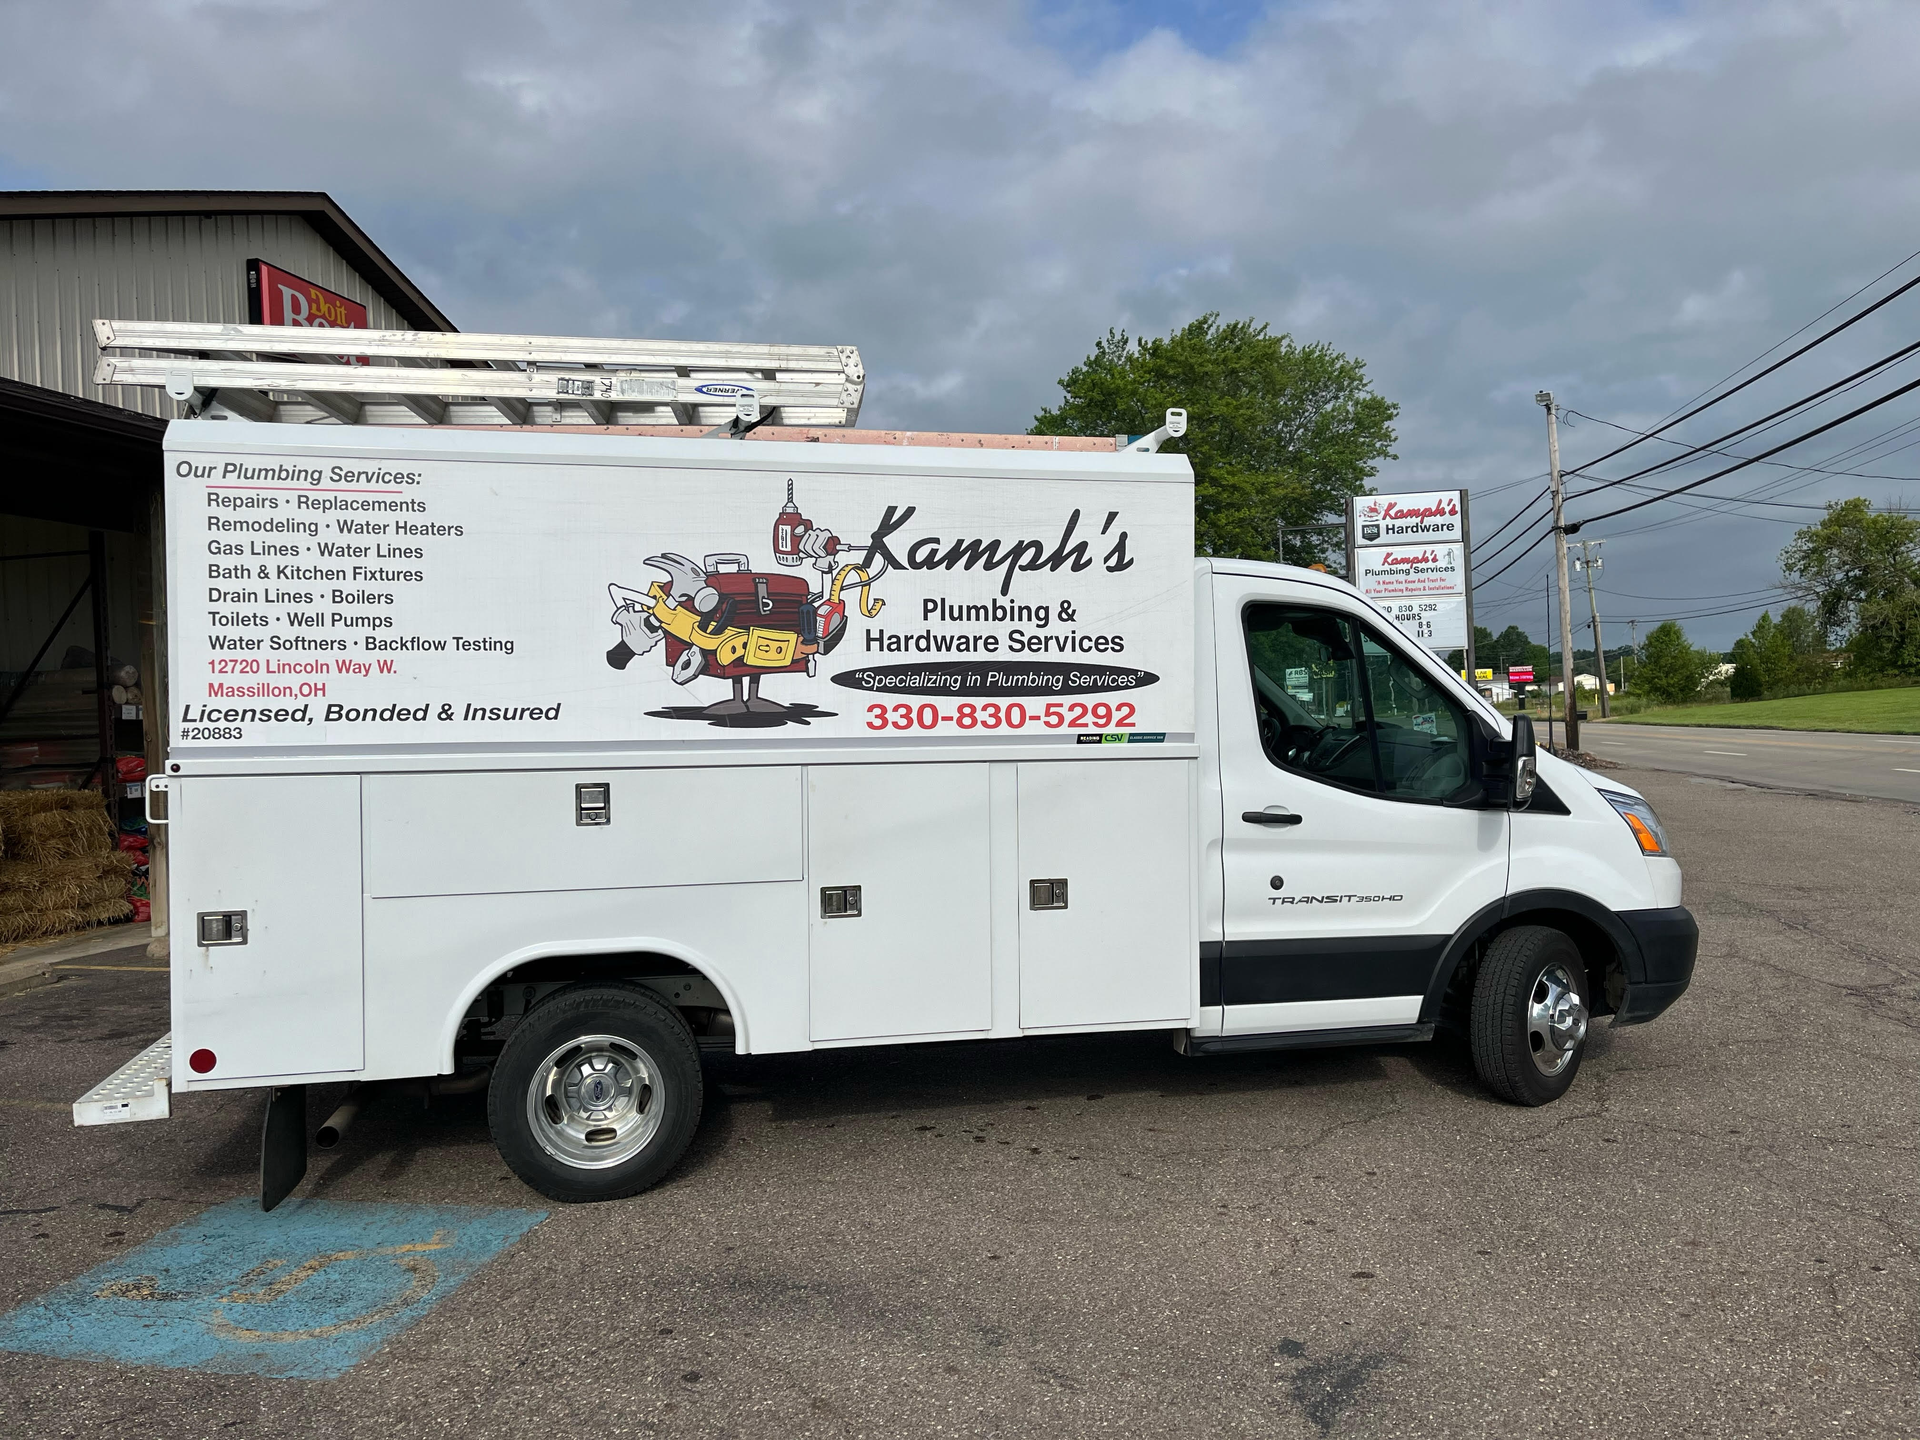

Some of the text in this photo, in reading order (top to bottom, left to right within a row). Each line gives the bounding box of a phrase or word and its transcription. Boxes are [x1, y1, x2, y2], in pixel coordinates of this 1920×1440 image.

[176, 461, 421, 486] Our Plumbing Services:
[208, 492, 426, 513] Repairs Replacements
[1382, 499, 1459, 525] Kamph's
[208, 516, 463, 537] Remodeling Water Heaters
[1386, 523, 1454, 534] Hardware
[208, 540, 423, 558] Gas Lines Water Lines
[860, 505, 1135, 598] Kamph's
[1381, 550, 1439, 569] Kamph's
[209, 564, 423, 581] Bath & Kitchen Fixtures
[1365, 565, 1455, 577] Plumbing Services
[209, 588, 393, 604] Drain Lines Boilers
[923, 598, 1076, 628] Plumbing &
[1395, 613, 1421, 621] HOURS
[1398, 604, 1414, 613] 830
[1418, 603, 1438, 612] 5292
[208, 612, 392, 631] Toilets Well Pumps
[208, 635, 513, 654] Water Softners Backflow Testing
[866, 629, 1124, 652] Hardware Services
[208, 659, 396, 677] 12720 Lincoln Way W.
[966, 672, 981, 687] in
[986, 671, 1064, 690] Plumbing
[209, 682, 325, 700] Massillon,OH
[182, 703, 561, 725] Licensed, Bonded & Insured
[866, 702, 1135, 730] 330-830-5292
[181, 727, 242, 740] #20883
[1104, 734, 1124, 742] CSV
